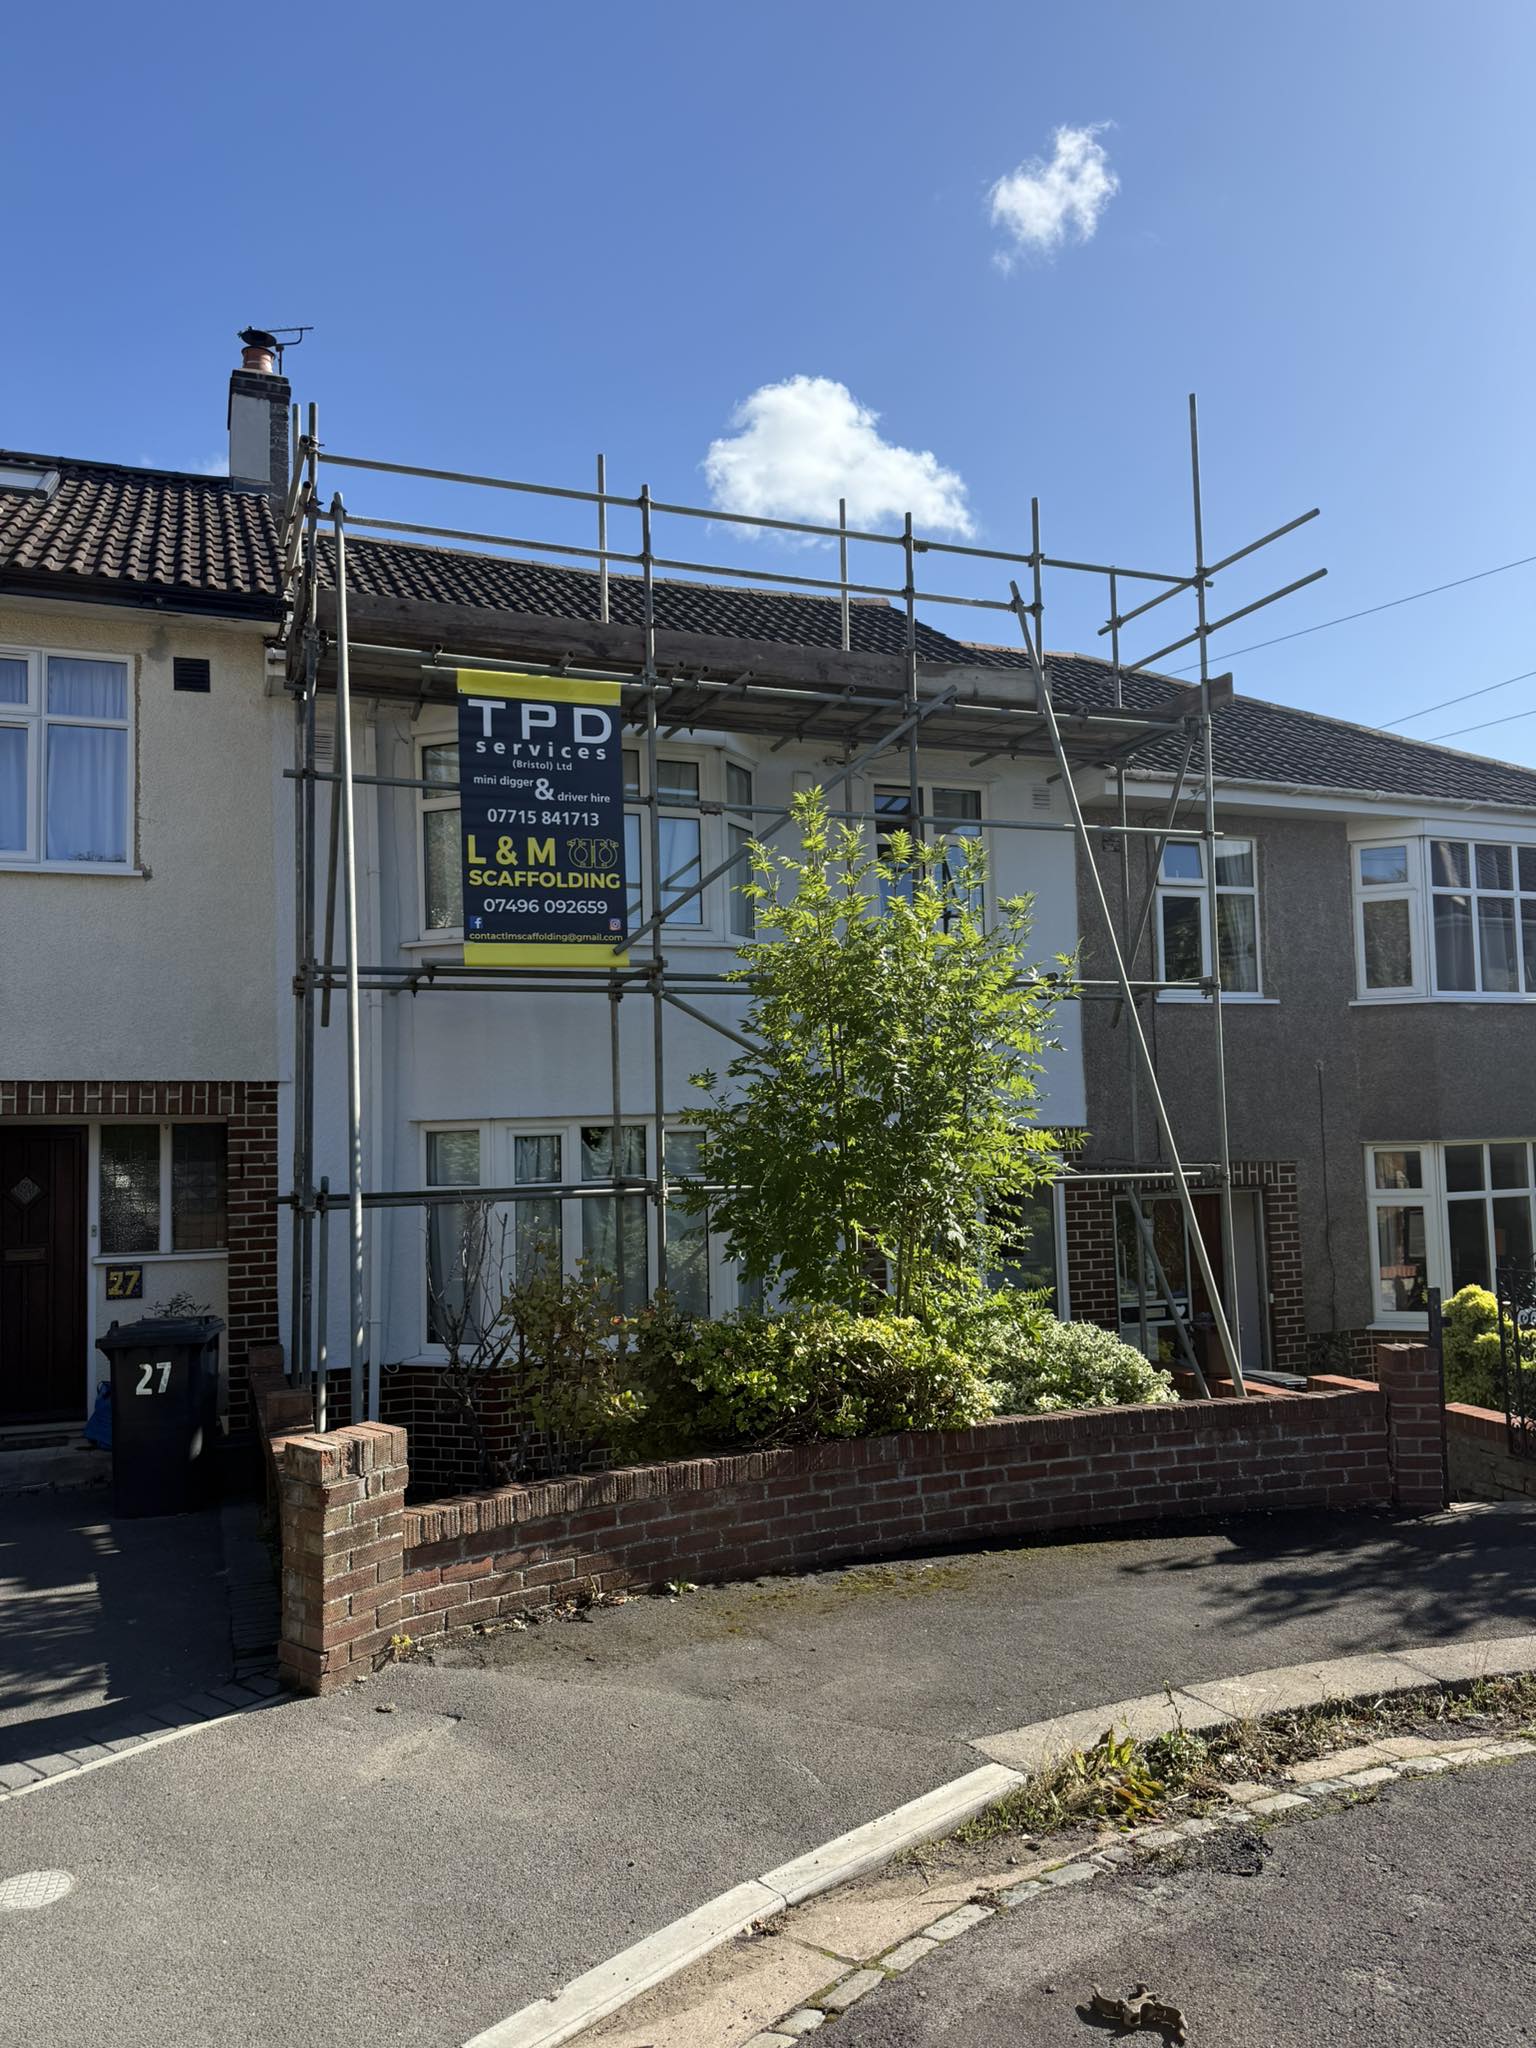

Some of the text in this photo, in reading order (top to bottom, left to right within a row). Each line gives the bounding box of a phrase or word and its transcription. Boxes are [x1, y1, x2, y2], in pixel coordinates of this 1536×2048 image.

[476, 741, 607, 760] services
[512, 759, 573, 771] (Bristol) Ltd
[473, 775, 611, 803] mini digger & driver hire
[487, 808, 600, 826] 07715 841713
[467, 834, 556, 866] L & M
[468, 869, 621, 889] SCAFFOLDING
[483, 898, 608, 914] 07496 092659
[108, 1270, 140, 1295] 27
[135, 1361, 172, 1396] 27
